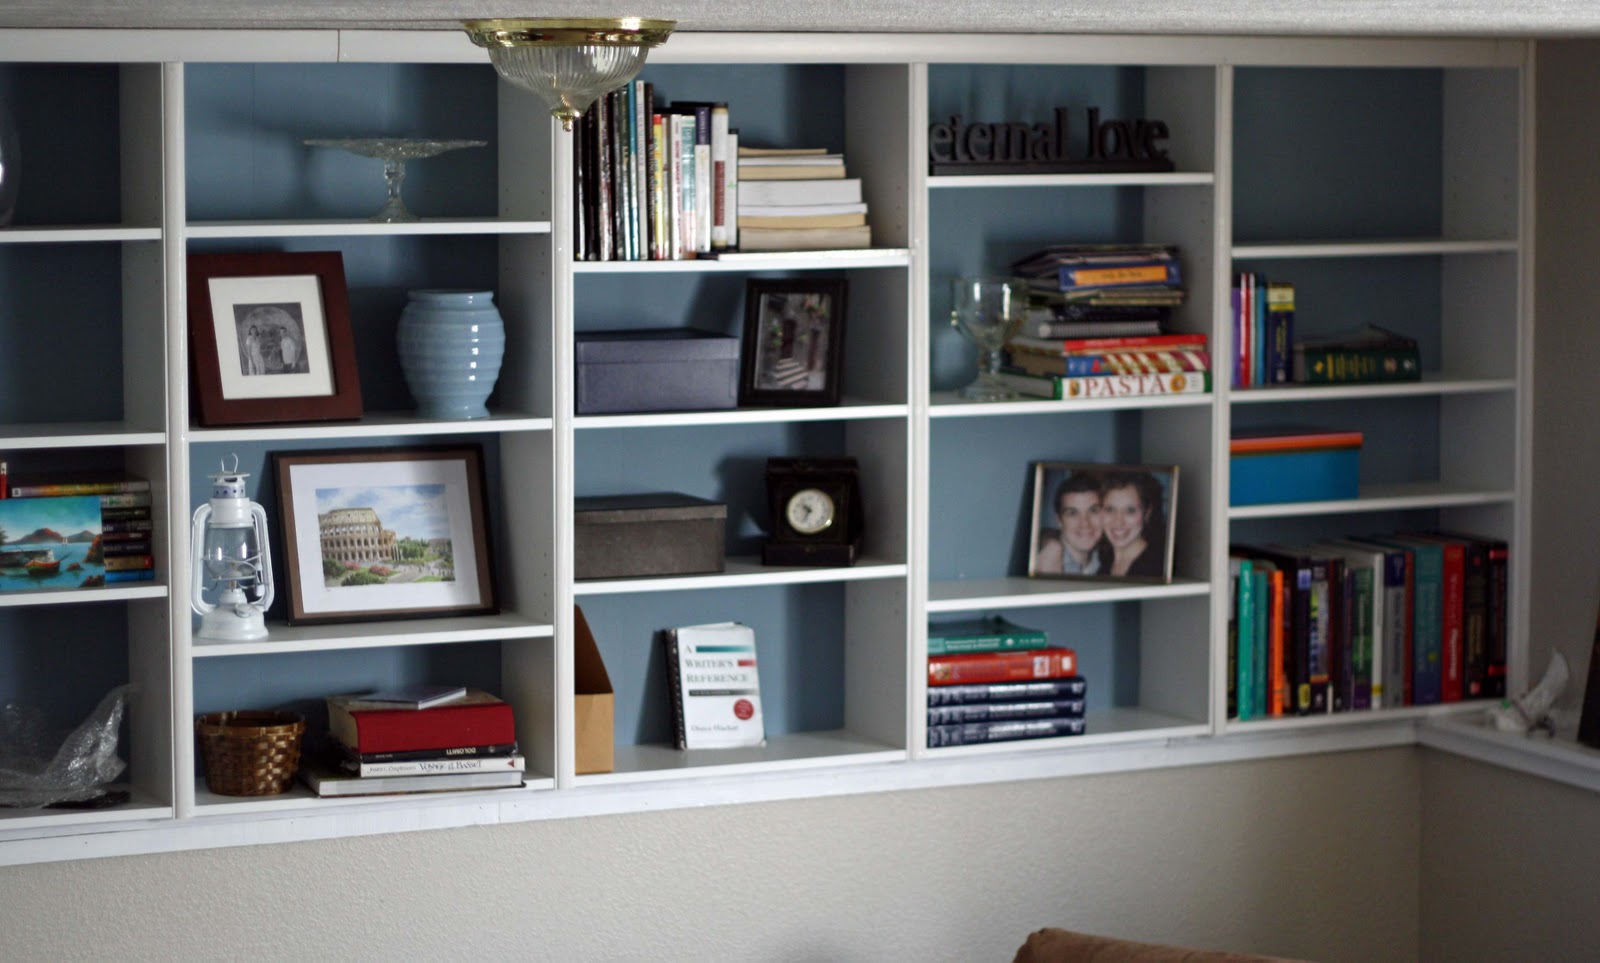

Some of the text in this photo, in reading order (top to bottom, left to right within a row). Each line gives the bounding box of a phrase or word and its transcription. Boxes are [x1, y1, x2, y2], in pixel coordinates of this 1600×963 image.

[928, 107, 1170, 162] eternal love
[1085, 374, 1166, 397] PASTA
[685, 645, 692, 654] A
[686, 673, 748, 683] REFERENCE
